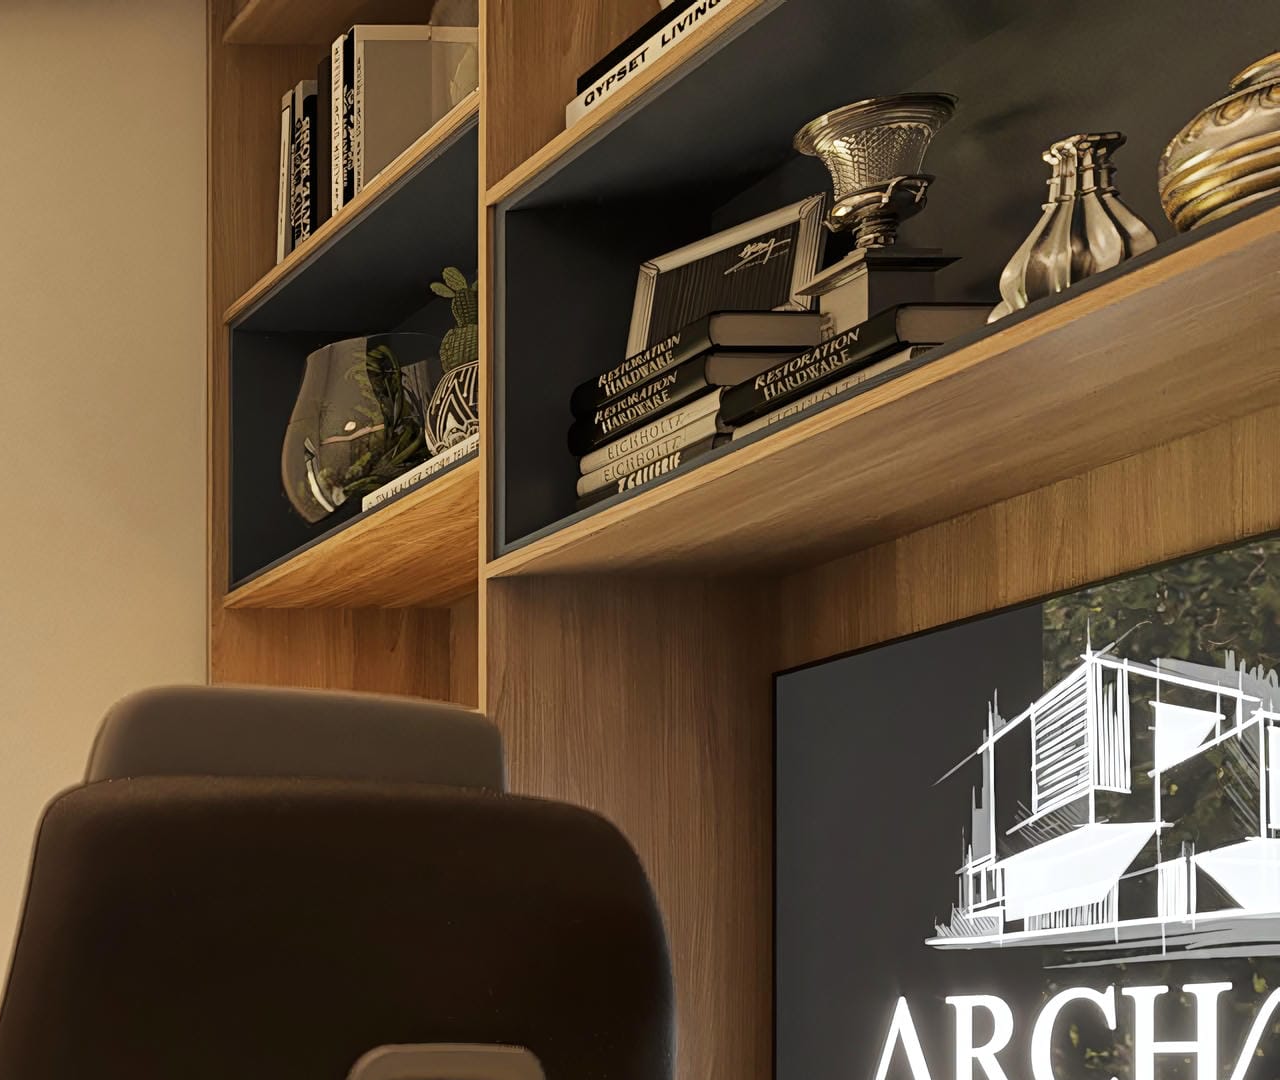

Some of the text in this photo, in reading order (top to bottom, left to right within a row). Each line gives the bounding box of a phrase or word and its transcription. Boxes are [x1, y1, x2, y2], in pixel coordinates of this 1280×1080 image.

[583, 47, 649, 107] GYPSET
[603, 350, 675, 398] HARDWARE
[753, 327, 861, 390] RESTORATION
[762, 348, 851, 401] HARDWARE
[600, 389, 671, 434] HARDWARE
